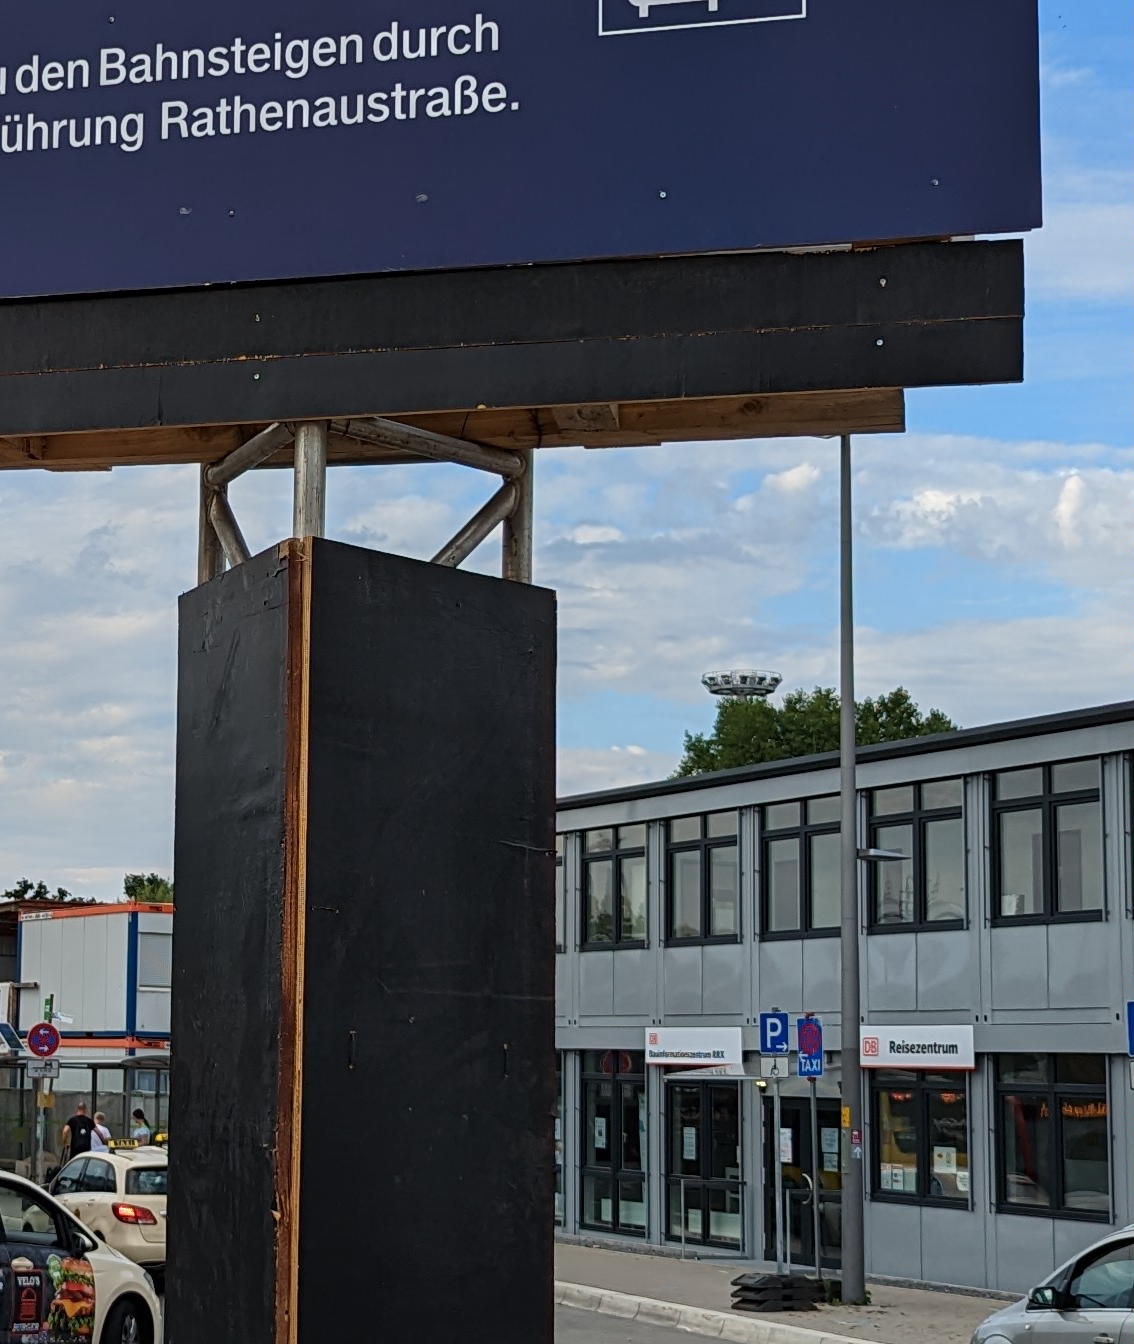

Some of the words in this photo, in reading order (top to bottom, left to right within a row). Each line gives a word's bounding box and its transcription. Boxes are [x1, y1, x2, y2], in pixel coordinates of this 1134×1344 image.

[15, 54, 90, 94] den
[99, 30, 364, 87] Bahnsteigen
[372, 13, 499, 62] durch
[160, 75, 520, 140] Rathenaustraße.
[766, 1017, 782, 1049] P
[649, 1049, 711, 1058] Bauinformationszentrum
[712, 1050, 725, 1059] RRX
[864, 1039, 878, 1054] DB
[889, 1039, 959, 1055] Reisezentrum
[800, 1058, 821, 1072] TAXI
